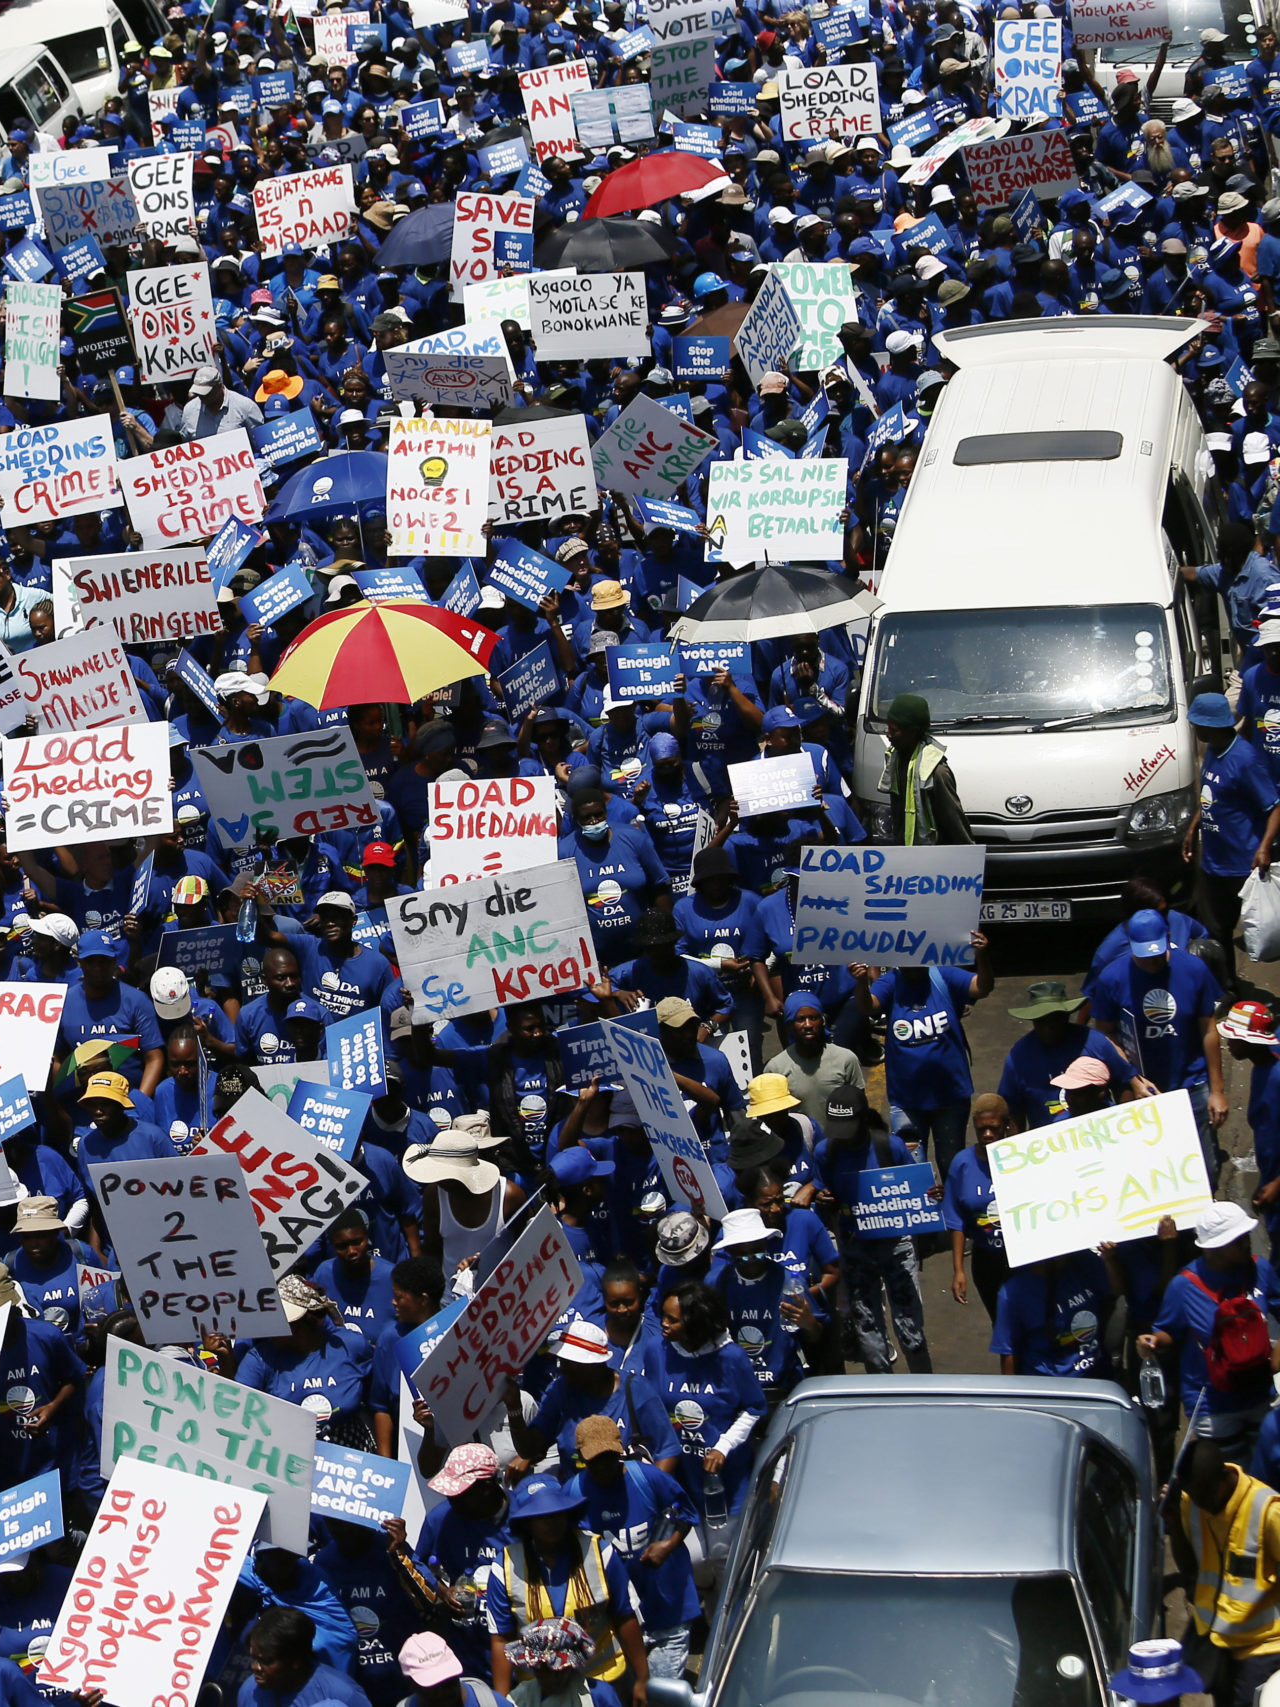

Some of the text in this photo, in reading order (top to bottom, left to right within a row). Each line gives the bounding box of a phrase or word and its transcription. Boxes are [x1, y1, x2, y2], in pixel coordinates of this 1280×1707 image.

[998, 22, 1060, 53] GEE
[787, 68, 868, 89] LOAD
[782, 89, 875, 109] SHEDDING
[997, 86, 1061, 117] KRAG
[806, 105, 845, 120] IS A
[789, 115, 872, 138] CRIME
[964, 132, 1069, 161] KGAOLO YA
[132, 159, 185, 189] GEE
[967, 150, 1076, 177] MOTLAKASE
[971, 176, 995, 192] KE
[143, 191, 189, 212] ONS
[259, 207, 282, 228] IS
[135, 274, 192, 305] GEE
[613, 275, 634, 292] YA
[631, 295, 645, 309] KE
[142, 307, 196, 340] ONS
[542, 311, 642, 334] BONOKWANE
[77, 336, 128, 354] #VOETSEK
[96, 349, 116, 360] ANC
[688, 346, 714, 357] Stop
[677, 366, 726, 375] increase!
[692, 357, 710, 365] the
[6, 426, 59, 451] LOAD
[151, 441, 205, 469] LOAD
[132, 450, 255, 497] SHEDDING
[711, 463, 838, 484] ONS SAL NIE
[164, 490, 192, 508] IS
[497, 475, 556, 500] IS A
[711, 488, 846, 511] VIR KORRUPSIE
[748, 512, 818, 538] BETAAL
[617, 655, 670, 670] Enough
[682, 646, 743, 659] vote out
[639, 670, 652, 681] is
[619, 682, 675, 696] enough!
[13, 726, 135, 773] Load
[1123, 744, 1176, 791] Halfway
[434, 778, 535, 811] LOAD
[432, 811, 558, 840] SHEDDING
[802, 849, 885, 875] LOAD
[864, 873, 983, 897] SHEDDING
[400, 880, 537, 936] Sny die
[1001, 902, 1017, 918] 25
[1024, 903, 1040, 918] JX
[1051, 903, 1068, 918] GP
[597, 916, 632, 928] VOTER
[466, 920, 559, 969] ANC
[796, 927, 926, 955] PROUDLY
[610, 1027, 666, 1079] STOP
[631, 1074, 678, 1119] THE
[642, 1122, 706, 1163] INCREASE
[100, 1173, 240, 1205] POWER
[871, 1181, 910, 1198] Load
[1118, 1154, 1202, 1211] ANC
[851, 1195, 922, 1216] shedding
[160, 1212, 198, 1243] 2
[856, 1212, 939, 1231] killing jobs
[138, 1250, 238, 1280] THE
[139, 1287, 278, 1319] PEOPLE
[117, 1348, 271, 1435] POWER
[143, 1400, 312, 1487] TO THE
[4, 1521, 20, 1537] is
[38, 1489, 135, 1683] Kgaolo ya
